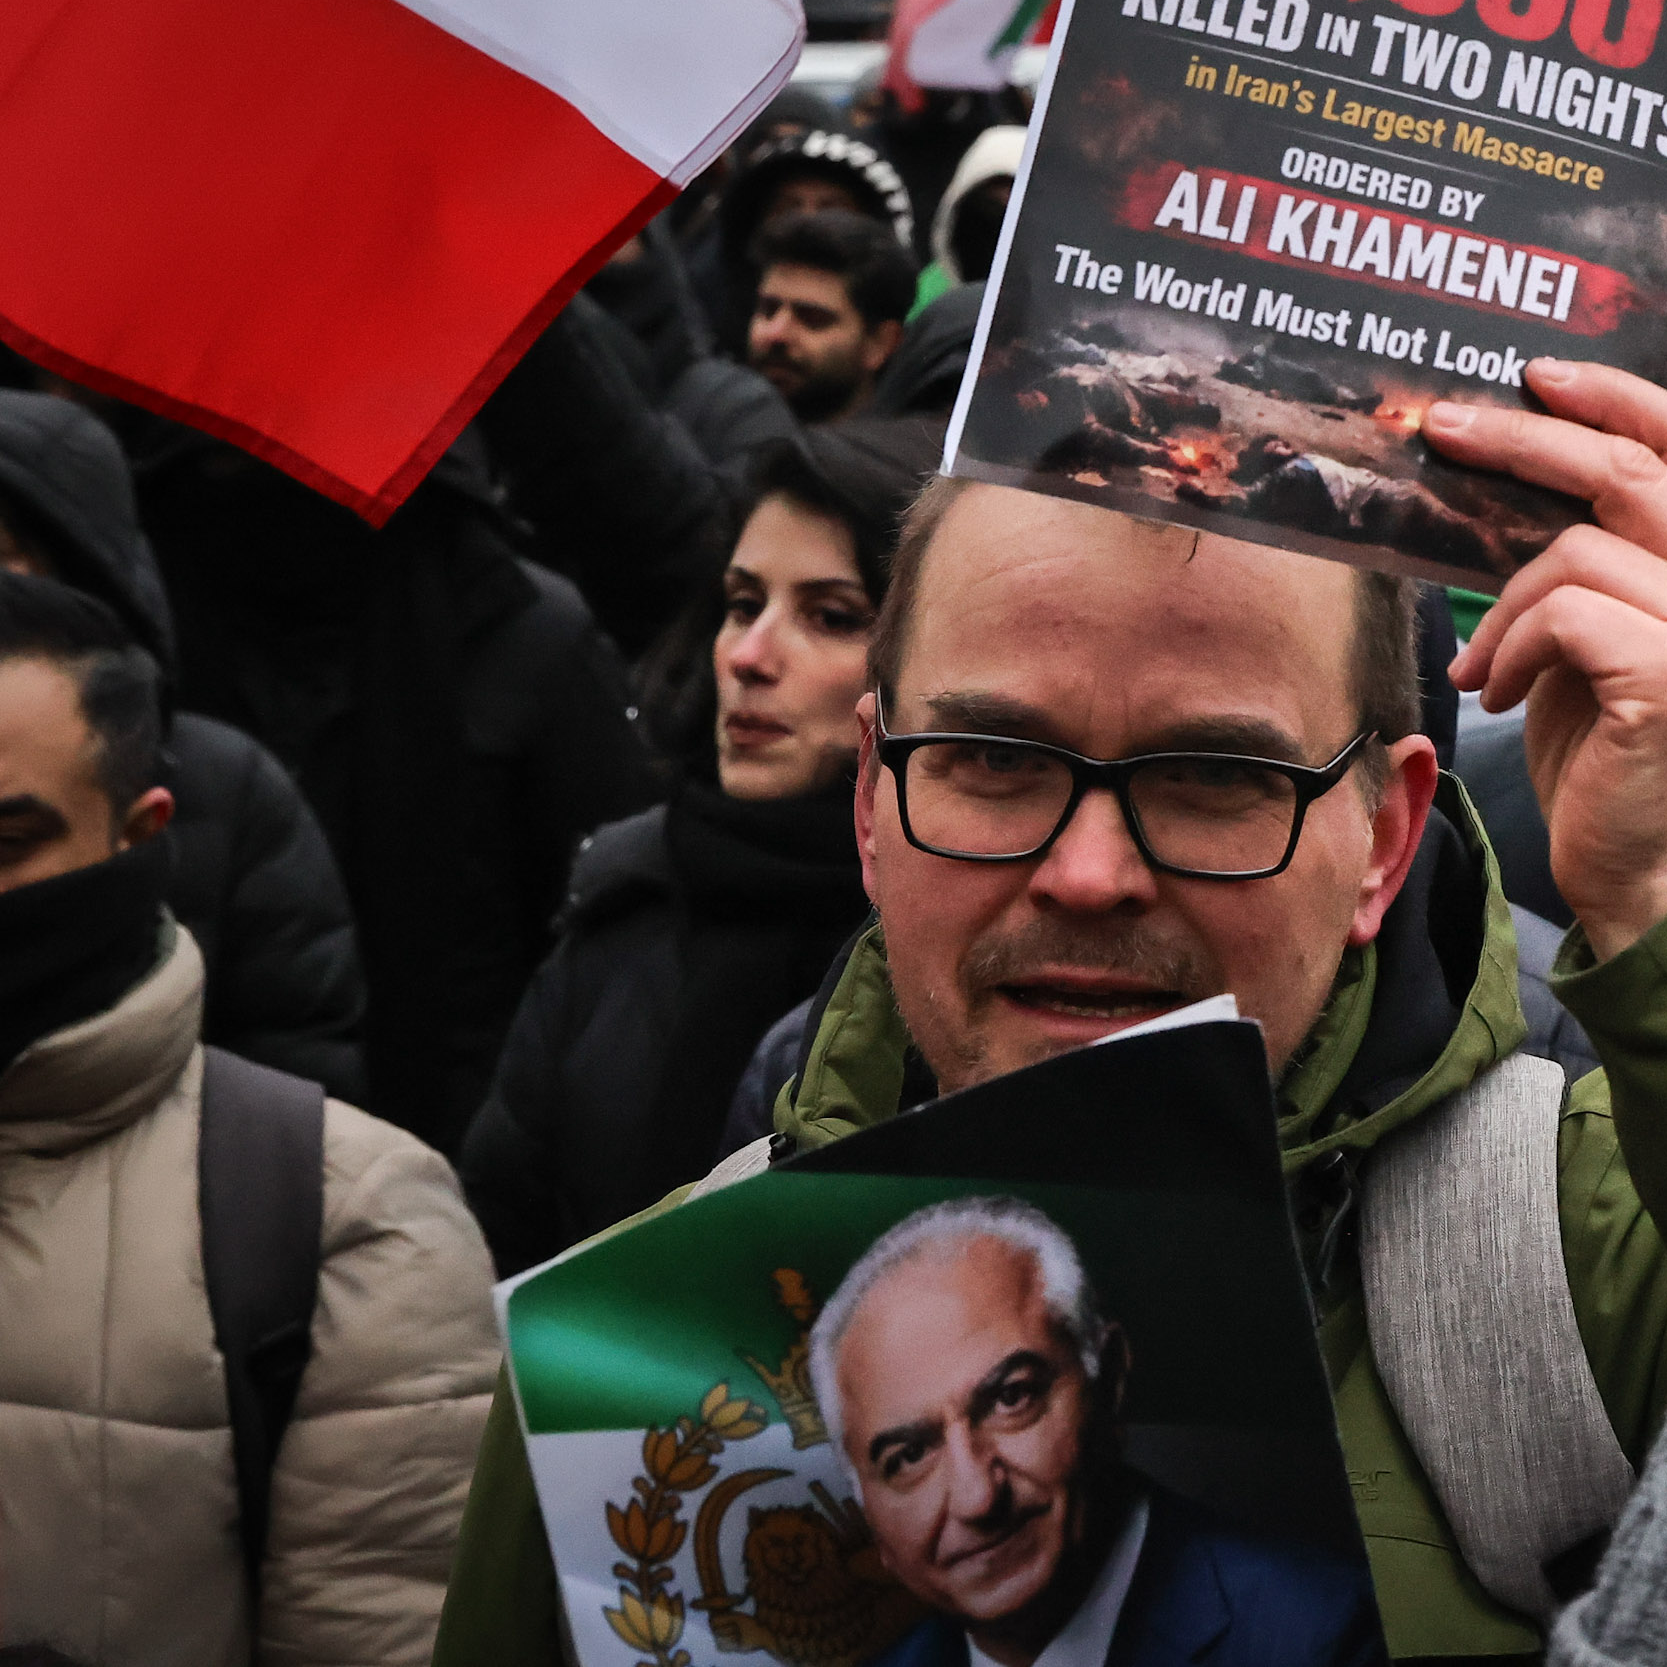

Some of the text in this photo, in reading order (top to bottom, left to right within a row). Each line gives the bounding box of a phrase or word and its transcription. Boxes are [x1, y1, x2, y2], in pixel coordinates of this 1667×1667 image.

[1185, 56, 1605, 191] in Iran's Largest Massacre
[1315, 12, 1360, 57] IN
[1369, 14, 1491, 100] TWO
[1154, 170, 1579, 322] ALI KHAMENEI
[1281, 147, 1485, 223] ORDERED BY
[1053, 244, 1527, 388] The World Must Not Look
